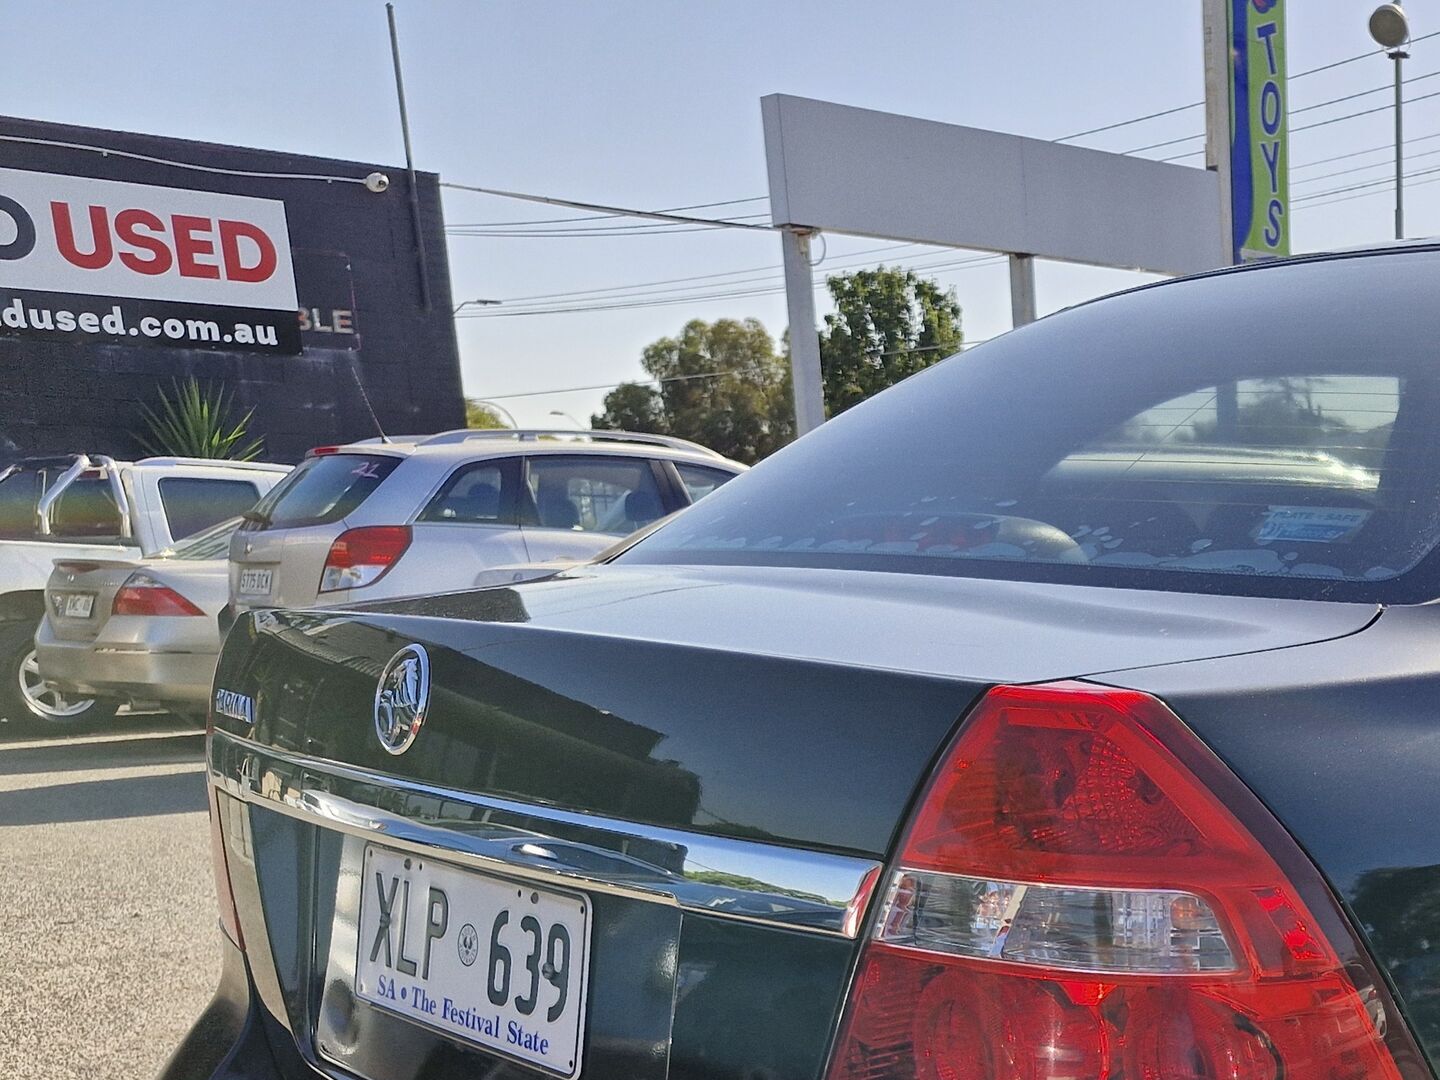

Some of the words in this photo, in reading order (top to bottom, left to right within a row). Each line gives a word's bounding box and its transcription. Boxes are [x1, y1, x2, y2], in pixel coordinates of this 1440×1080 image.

[1256, 22, 1283, 248] TOYS
[50, 200, 278, 284] USED
[0, 297, 279, 347] dused.com.au
[369, 871, 449, 980] XLP
[487, 909, 571, 1023] 639
[376, 974, 396, 1001] SA
[411, 985, 437, 1016] The
[442, 997, 500, 1038] Festival
[506, 1021, 549, 1056] State
